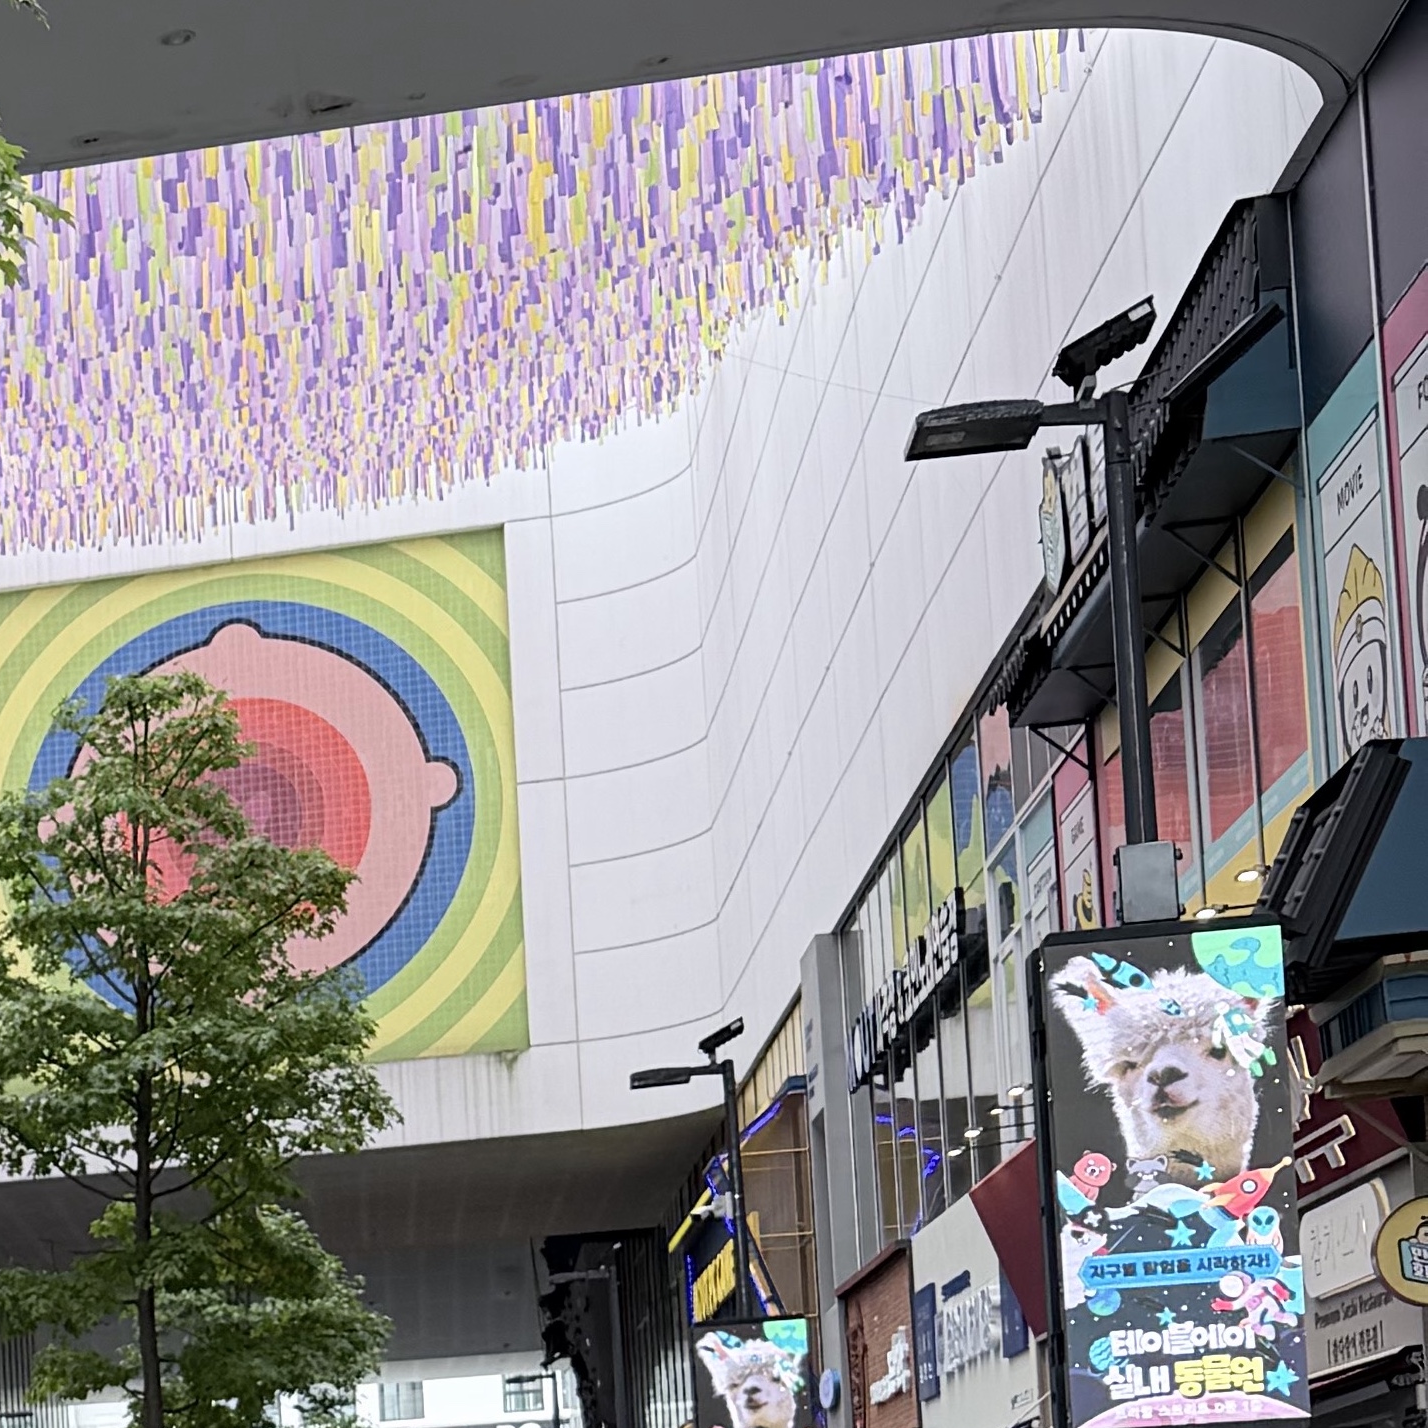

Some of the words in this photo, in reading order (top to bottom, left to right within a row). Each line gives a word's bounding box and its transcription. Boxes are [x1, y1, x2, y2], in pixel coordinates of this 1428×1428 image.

[1337, 464, 1363, 516] MOVIE
[1090, 1265, 1137, 1279] 지구별
[1197, 1253, 1270, 1271] 시작하자!
[1110, 1321, 1256, 1357] 테이블에이
[1103, 1364, 1171, 1400] 실내
[1174, 1354, 1265, 1397] 동물원
